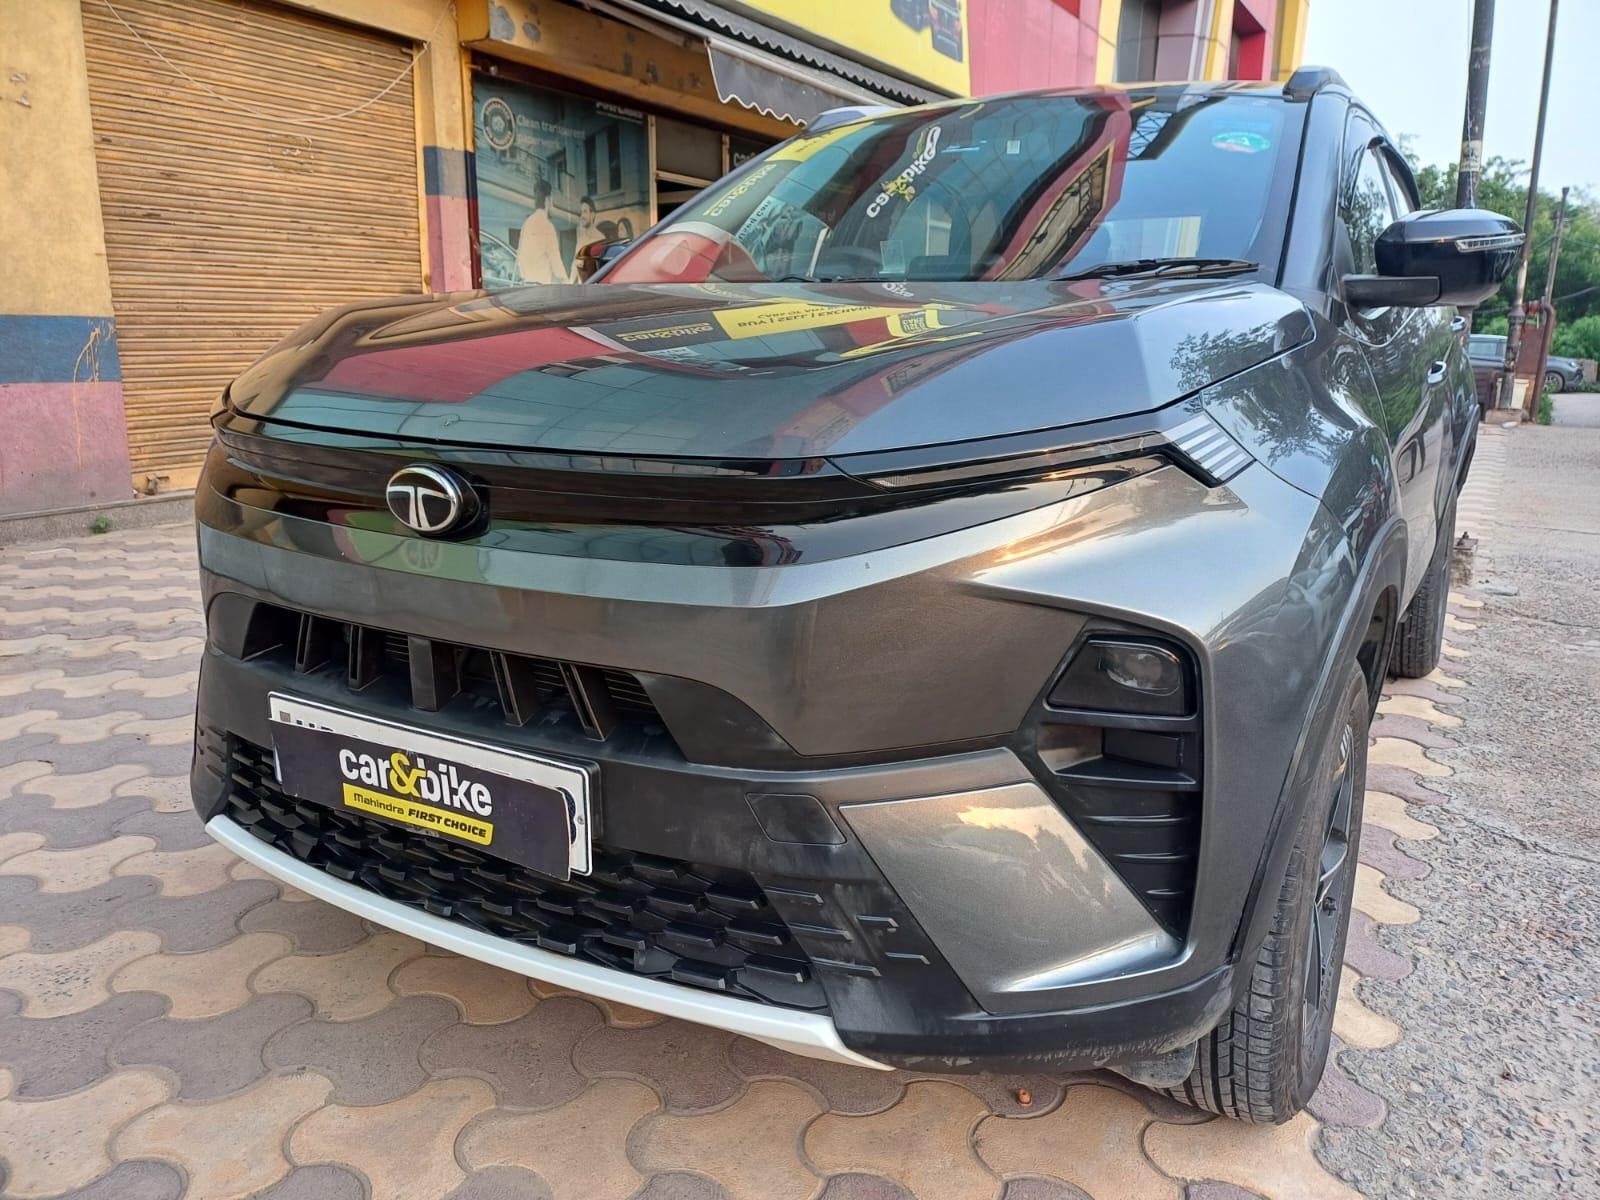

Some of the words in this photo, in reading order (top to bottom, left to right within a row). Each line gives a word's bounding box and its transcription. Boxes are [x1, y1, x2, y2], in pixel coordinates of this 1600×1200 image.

[339, 748, 493, 816] car&bike
[353, 792, 405, 815] Mahindra
[407, 807, 443, 826] FIRST
[443, 817, 488, 838] CHOICE
